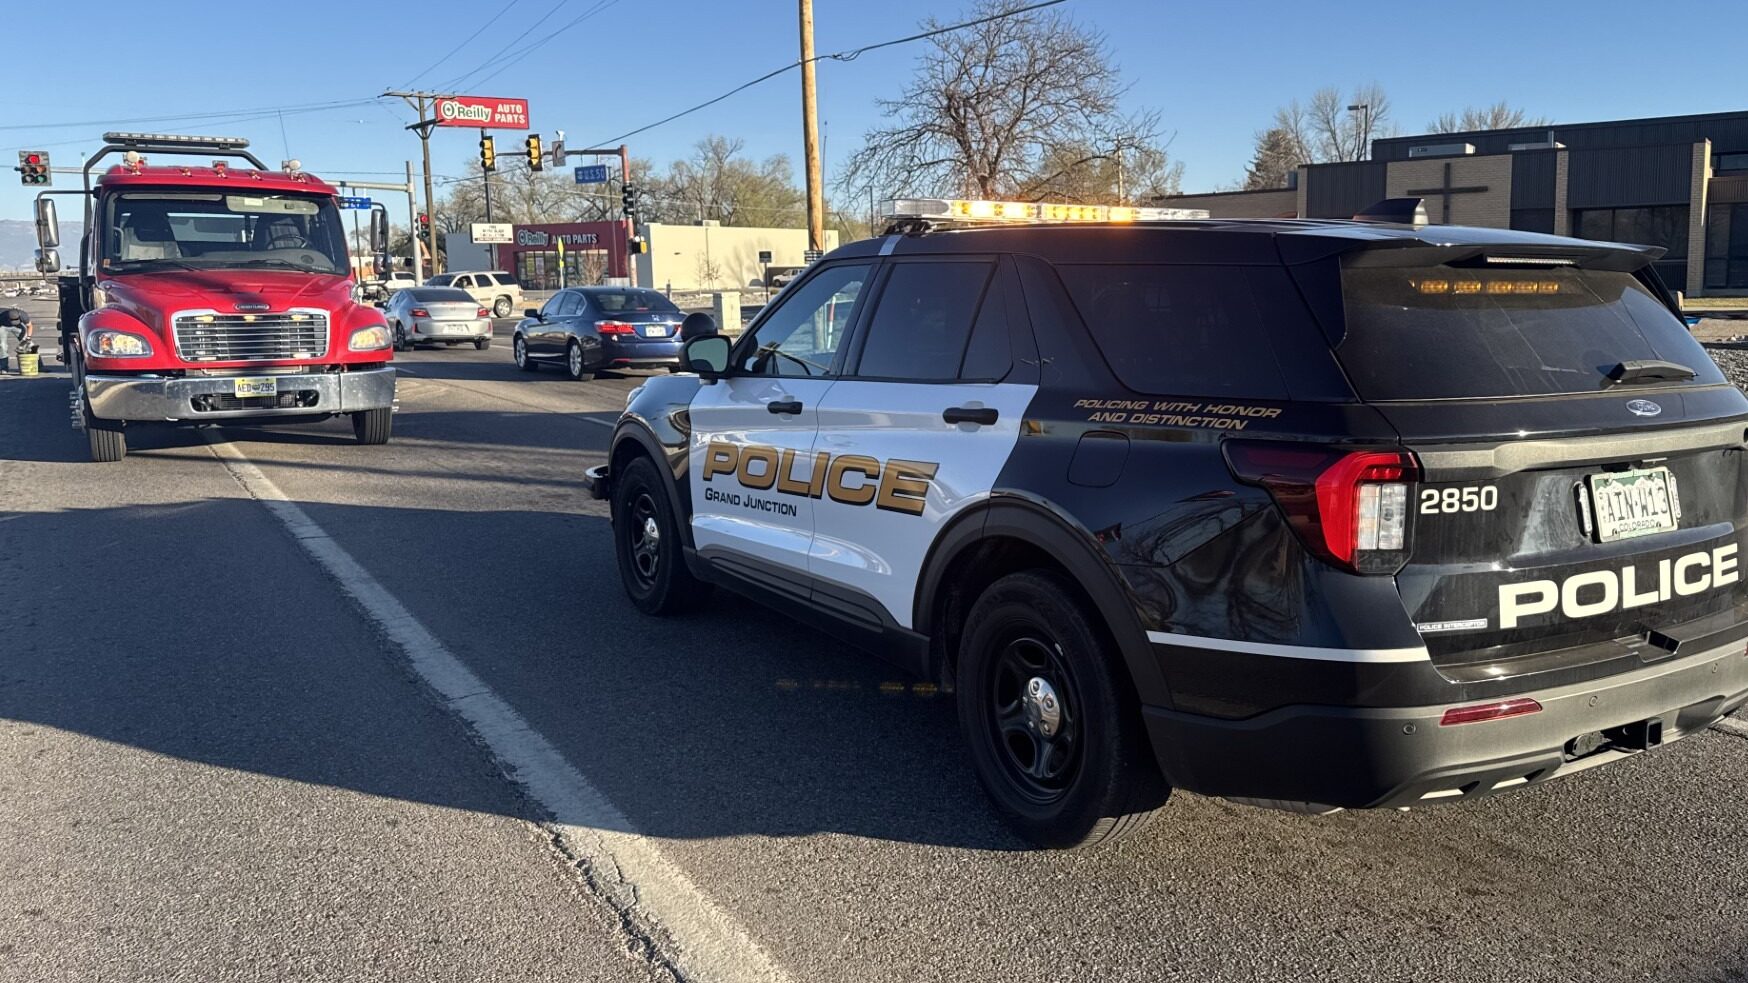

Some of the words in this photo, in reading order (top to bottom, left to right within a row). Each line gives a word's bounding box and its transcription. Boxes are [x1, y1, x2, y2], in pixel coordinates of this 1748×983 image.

[442, 101, 491, 122] O'Reilly
[497, 104, 522, 113] AUTO
[495, 113, 525, 124] PARTS
[572, 234, 597, 244] PARTS
[1073, 399, 1149, 410] POLICING
[1153, 401, 1201, 412] WITH
[1203, 403, 1283, 418] HONOR
[1088, 412, 1128, 422] AND
[1128, 413, 1248, 430] DISTINCTION
[703, 441, 940, 517] POLICE
[1420, 485, 1499, 515] 2850
[1619, 519, 1656, 532] COLORADO
[1498, 543, 1739, 630] POLICE
